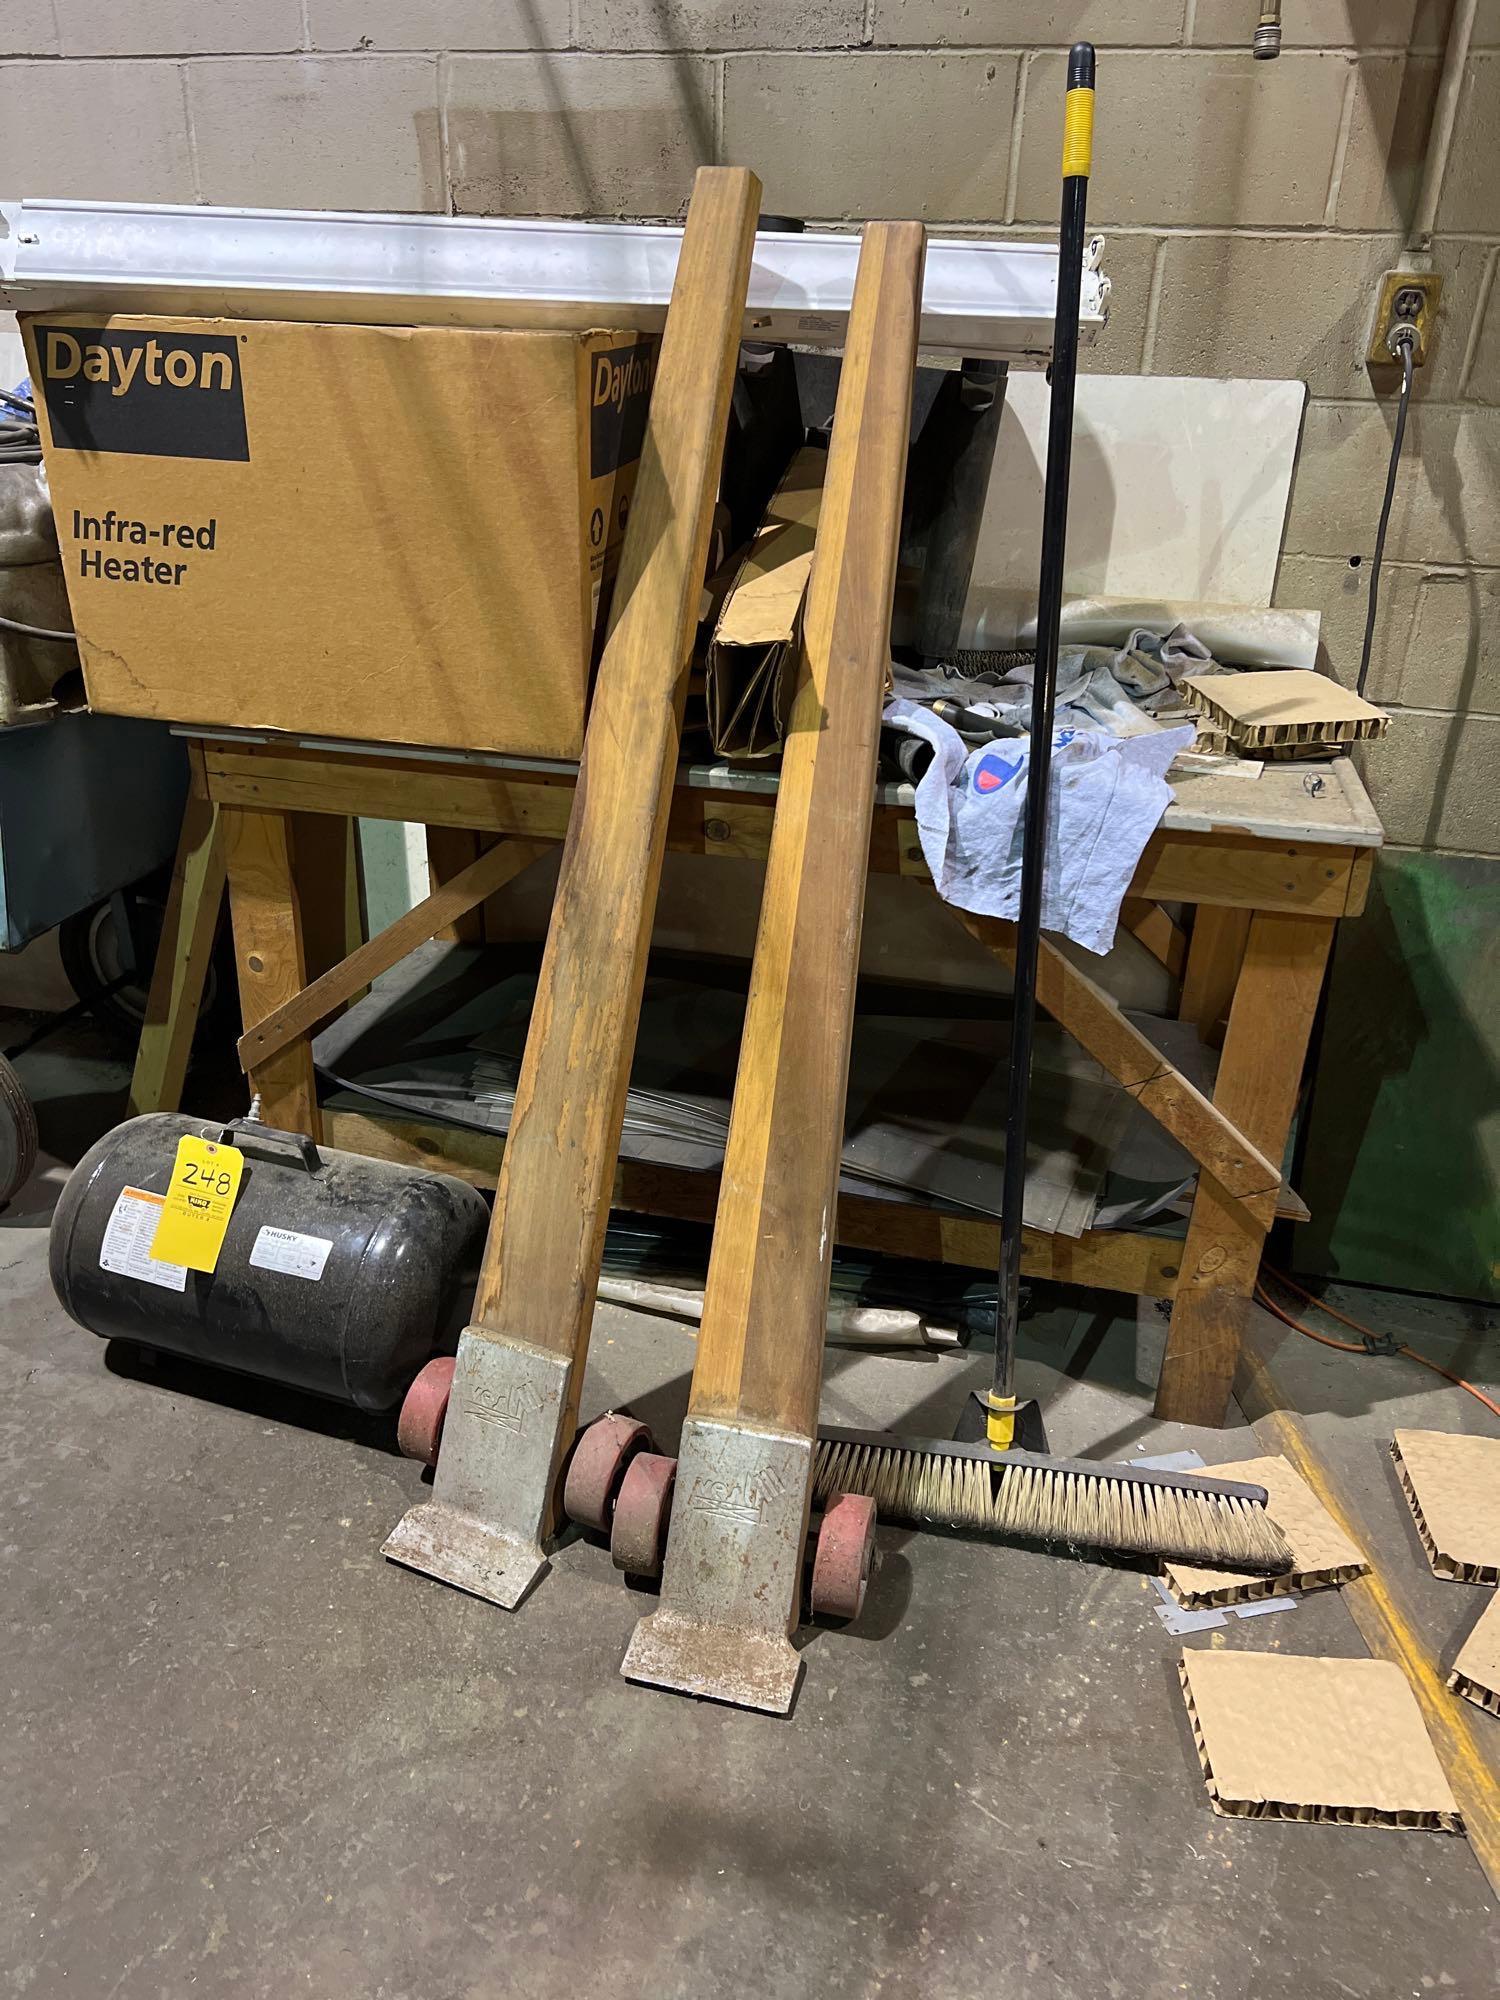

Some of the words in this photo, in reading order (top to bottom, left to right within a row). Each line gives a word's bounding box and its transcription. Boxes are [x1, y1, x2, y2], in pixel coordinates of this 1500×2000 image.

[46, 331, 233, 397] Dayton
[593, 352, 650, 414] Dayton
[73, 510, 216, 550] Infra-red
[80, 549, 187, 585] Heater
[182, 1163, 231, 1196] 248
[271, 1231, 297, 1242] HUSKY
